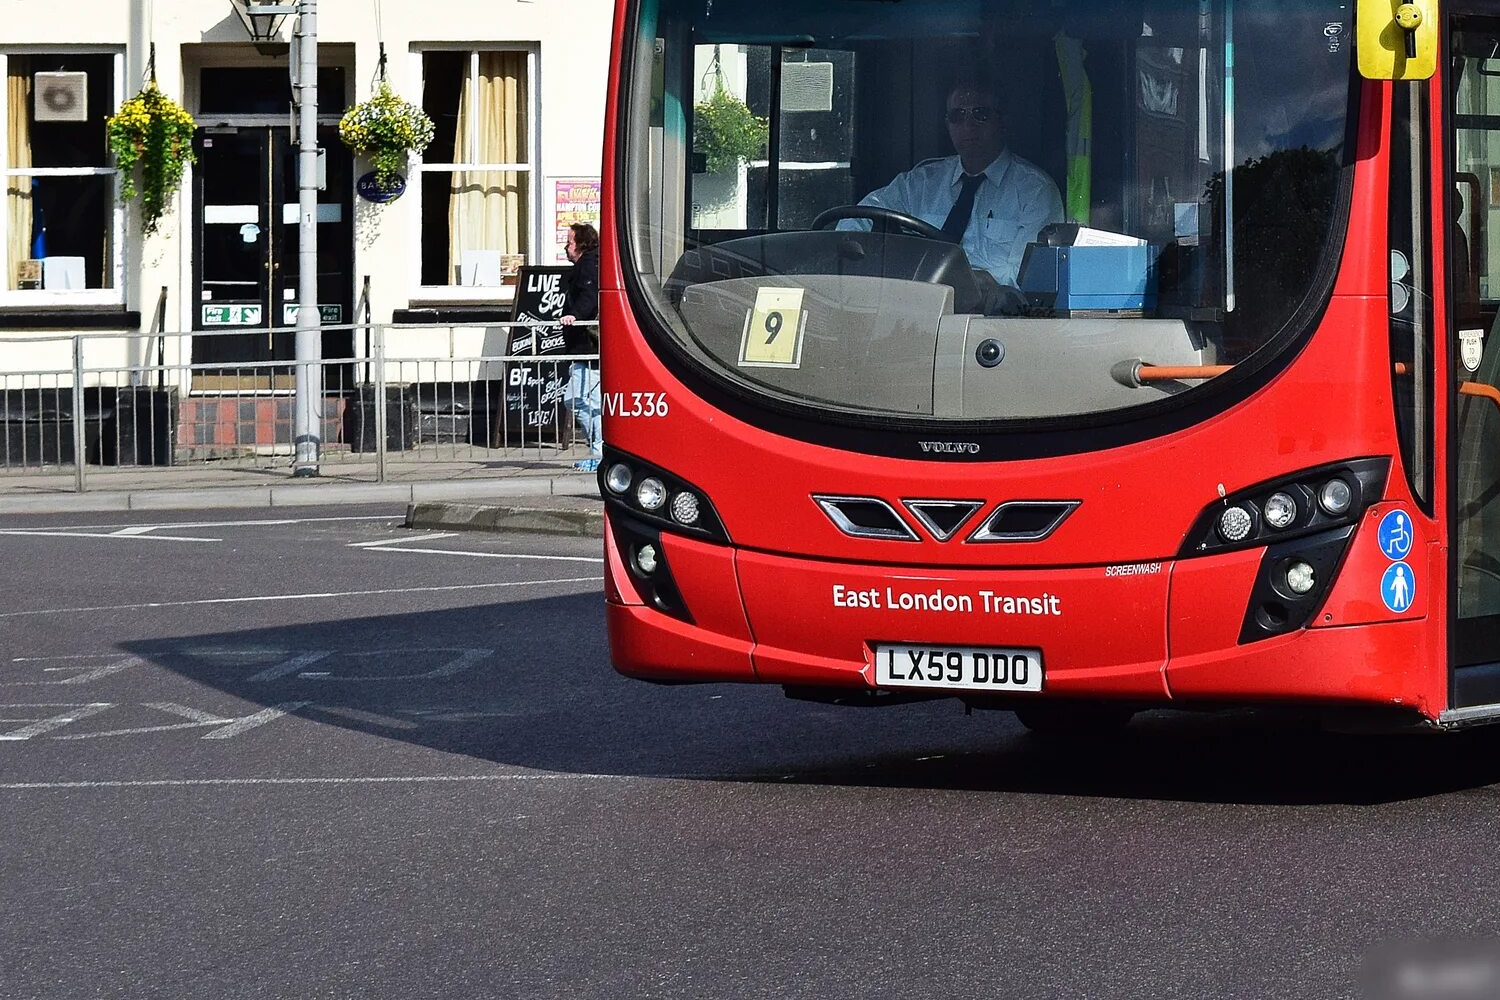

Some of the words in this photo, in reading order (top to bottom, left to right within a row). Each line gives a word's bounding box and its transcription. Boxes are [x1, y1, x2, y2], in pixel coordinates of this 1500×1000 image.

[527, 274, 562, 293] LIVE
[323, 306, 338, 314] Fire
[764, 311, 784, 345] 9
[510, 368, 532, 386] BT
[918, 441, 980, 454] VOLVO
[1105, 562, 1161, 577] SCREENWASH
[832, 585, 880, 608] East
[887, 586, 973, 613] London
[979, 591, 1061, 616] Transit
[889, 649, 963, 683] LX59
[972, 653, 1029, 685] DDO
